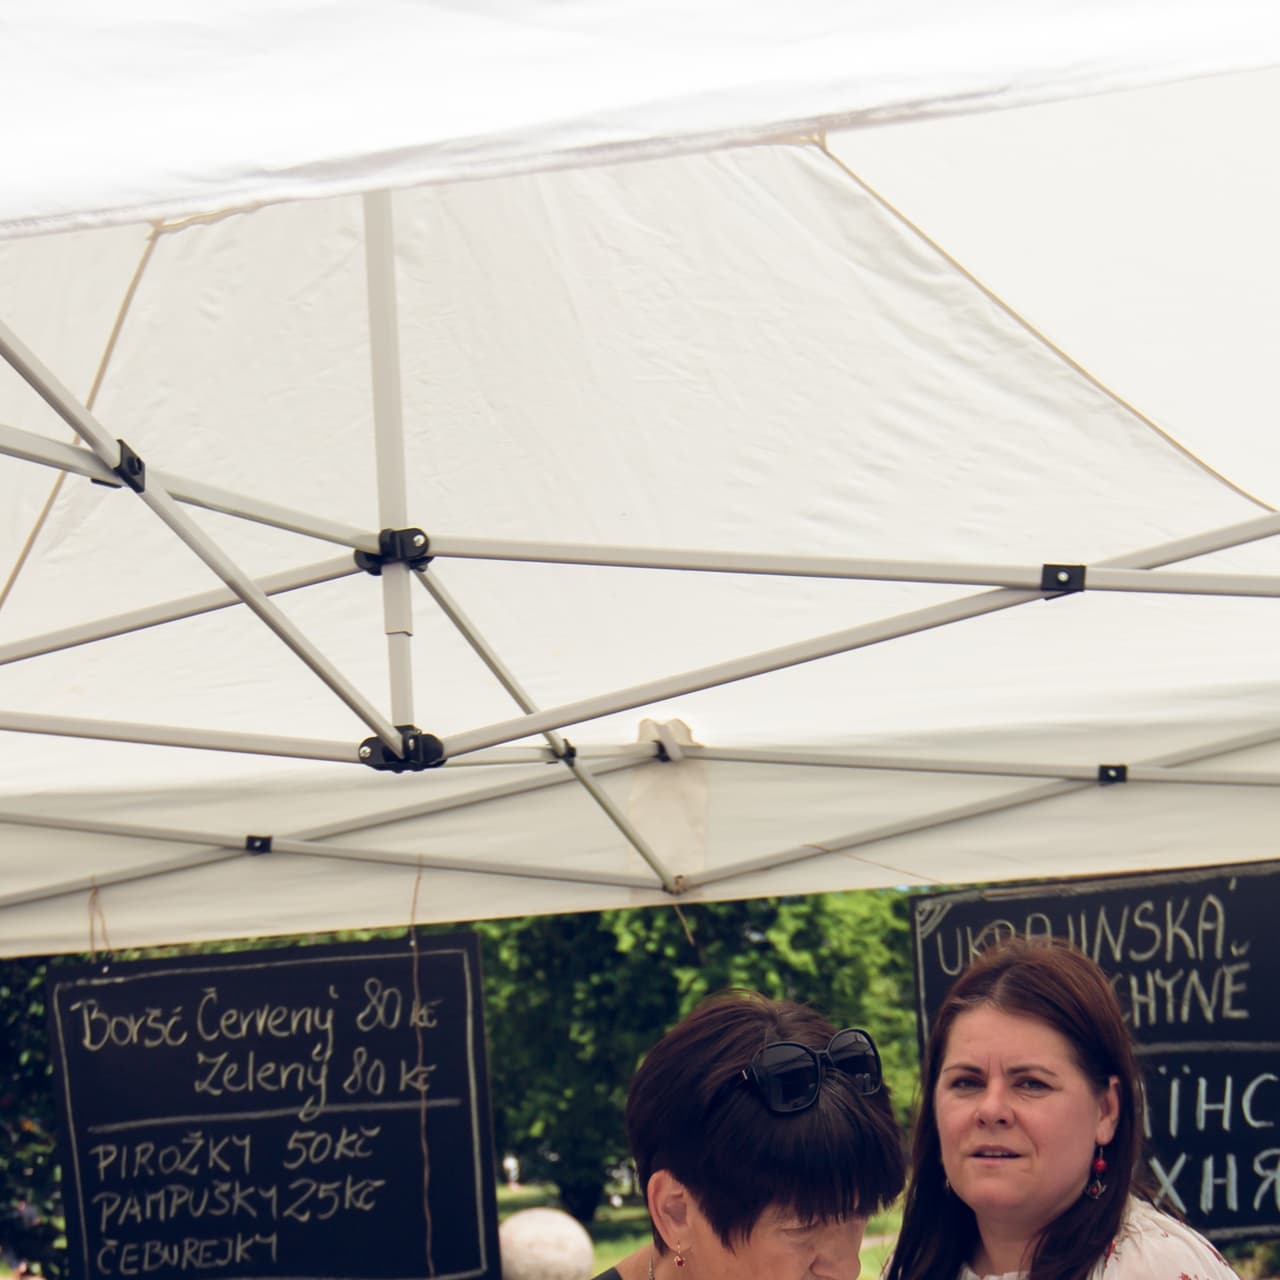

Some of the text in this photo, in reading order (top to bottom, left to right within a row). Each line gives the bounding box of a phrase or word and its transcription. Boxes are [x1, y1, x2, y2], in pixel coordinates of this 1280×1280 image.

[356, 977, 402, 1032] 80
[1111, 940, 1250, 1028] HYNĚ
[343, 1046, 385, 1095] 80
[89, 1131, 252, 1182] PIROŽKY
[92, 1178, 278, 1232] PAMPUŠKY
